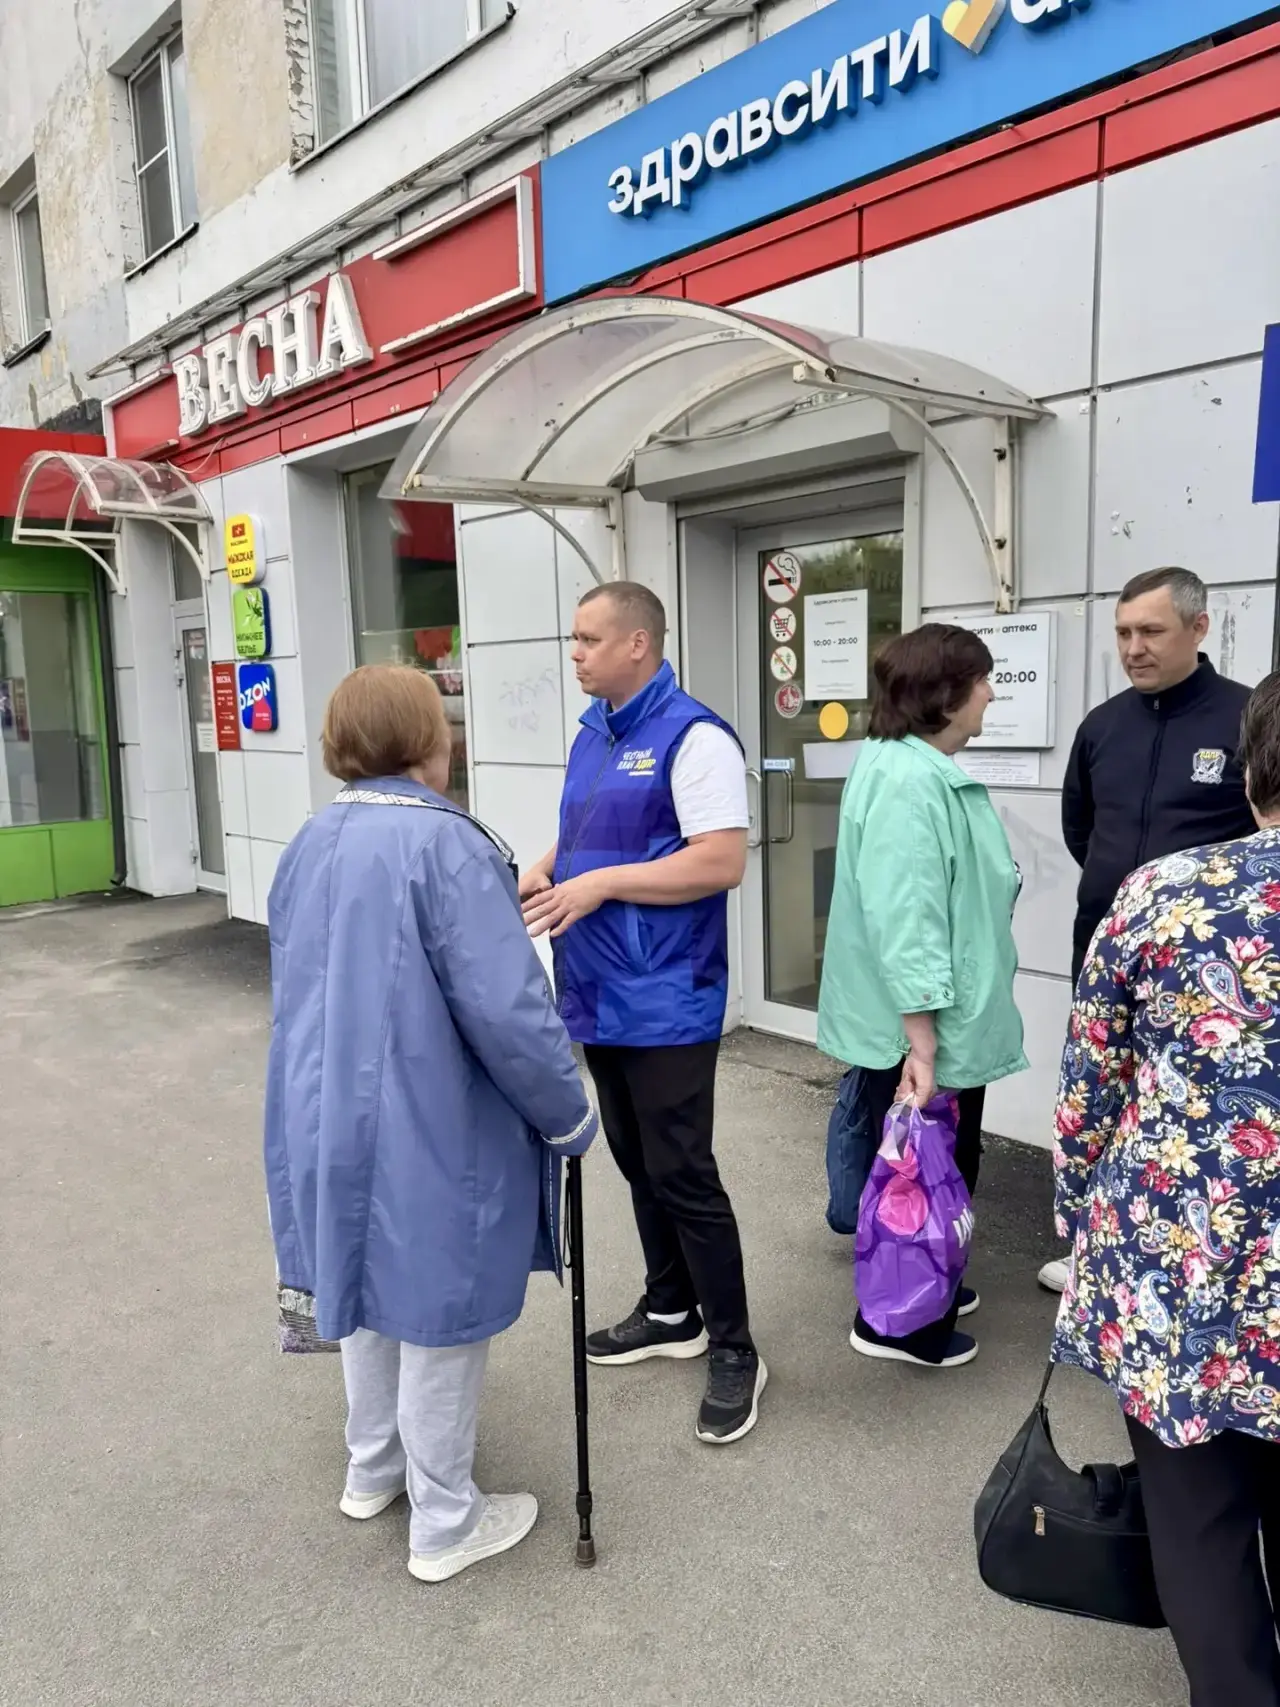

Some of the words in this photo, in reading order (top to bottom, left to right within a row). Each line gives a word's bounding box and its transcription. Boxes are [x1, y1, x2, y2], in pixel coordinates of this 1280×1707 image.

[607, 14, 932, 216] здравсити
[172, 272, 371, 436] ВЕСНА
[1002, 624, 1037, 633] аптека
[813, 639, 831, 647] 10:00
[838, 637, 858, 645] 20:00
[995, 670, 1037, 684] 20:00
[239, 677, 271, 711] OZON
